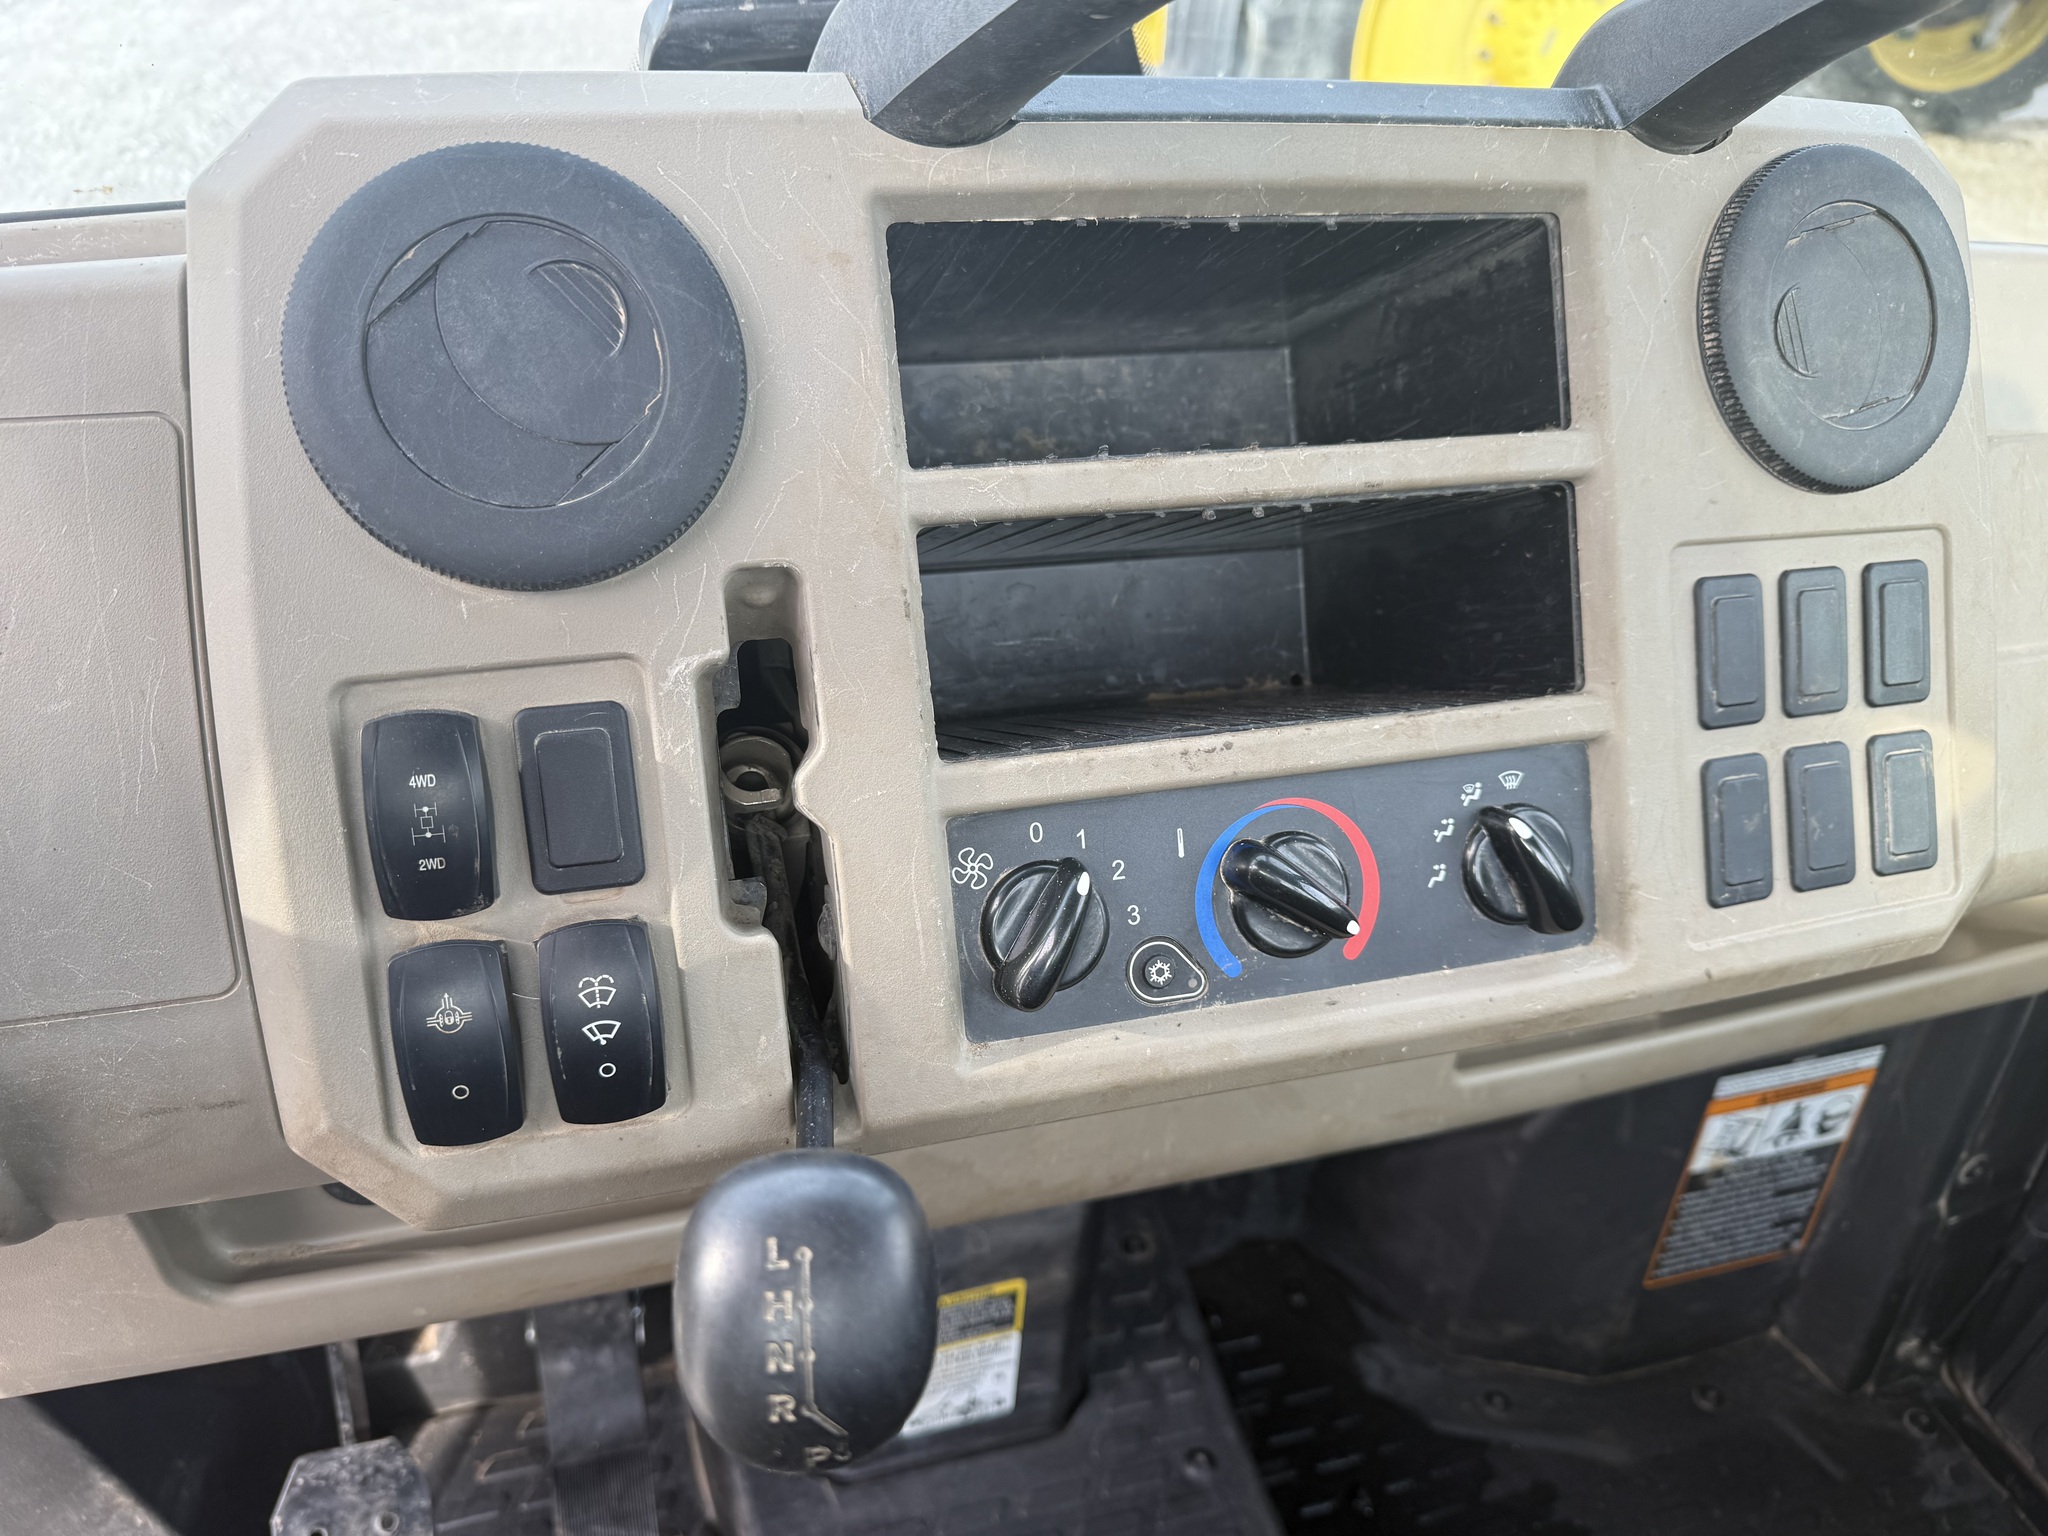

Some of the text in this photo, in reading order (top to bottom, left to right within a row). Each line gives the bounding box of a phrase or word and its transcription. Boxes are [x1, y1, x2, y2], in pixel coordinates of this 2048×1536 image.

[408, 773, 437, 789] 4WD
[1029, 821, 1044, 843] 0
[1076, 828, 1086, 850] 1
[419, 857, 447, 871] 2WD
[1111, 859, 1126, 881] 2
[1127, 903, 1141, 926] 3
[765, 1236, 790, 1271] L
[763, 1290, 794, 1323] H
[766, 1341, 795, 1375] N
[766, 1393, 798, 1424] R
